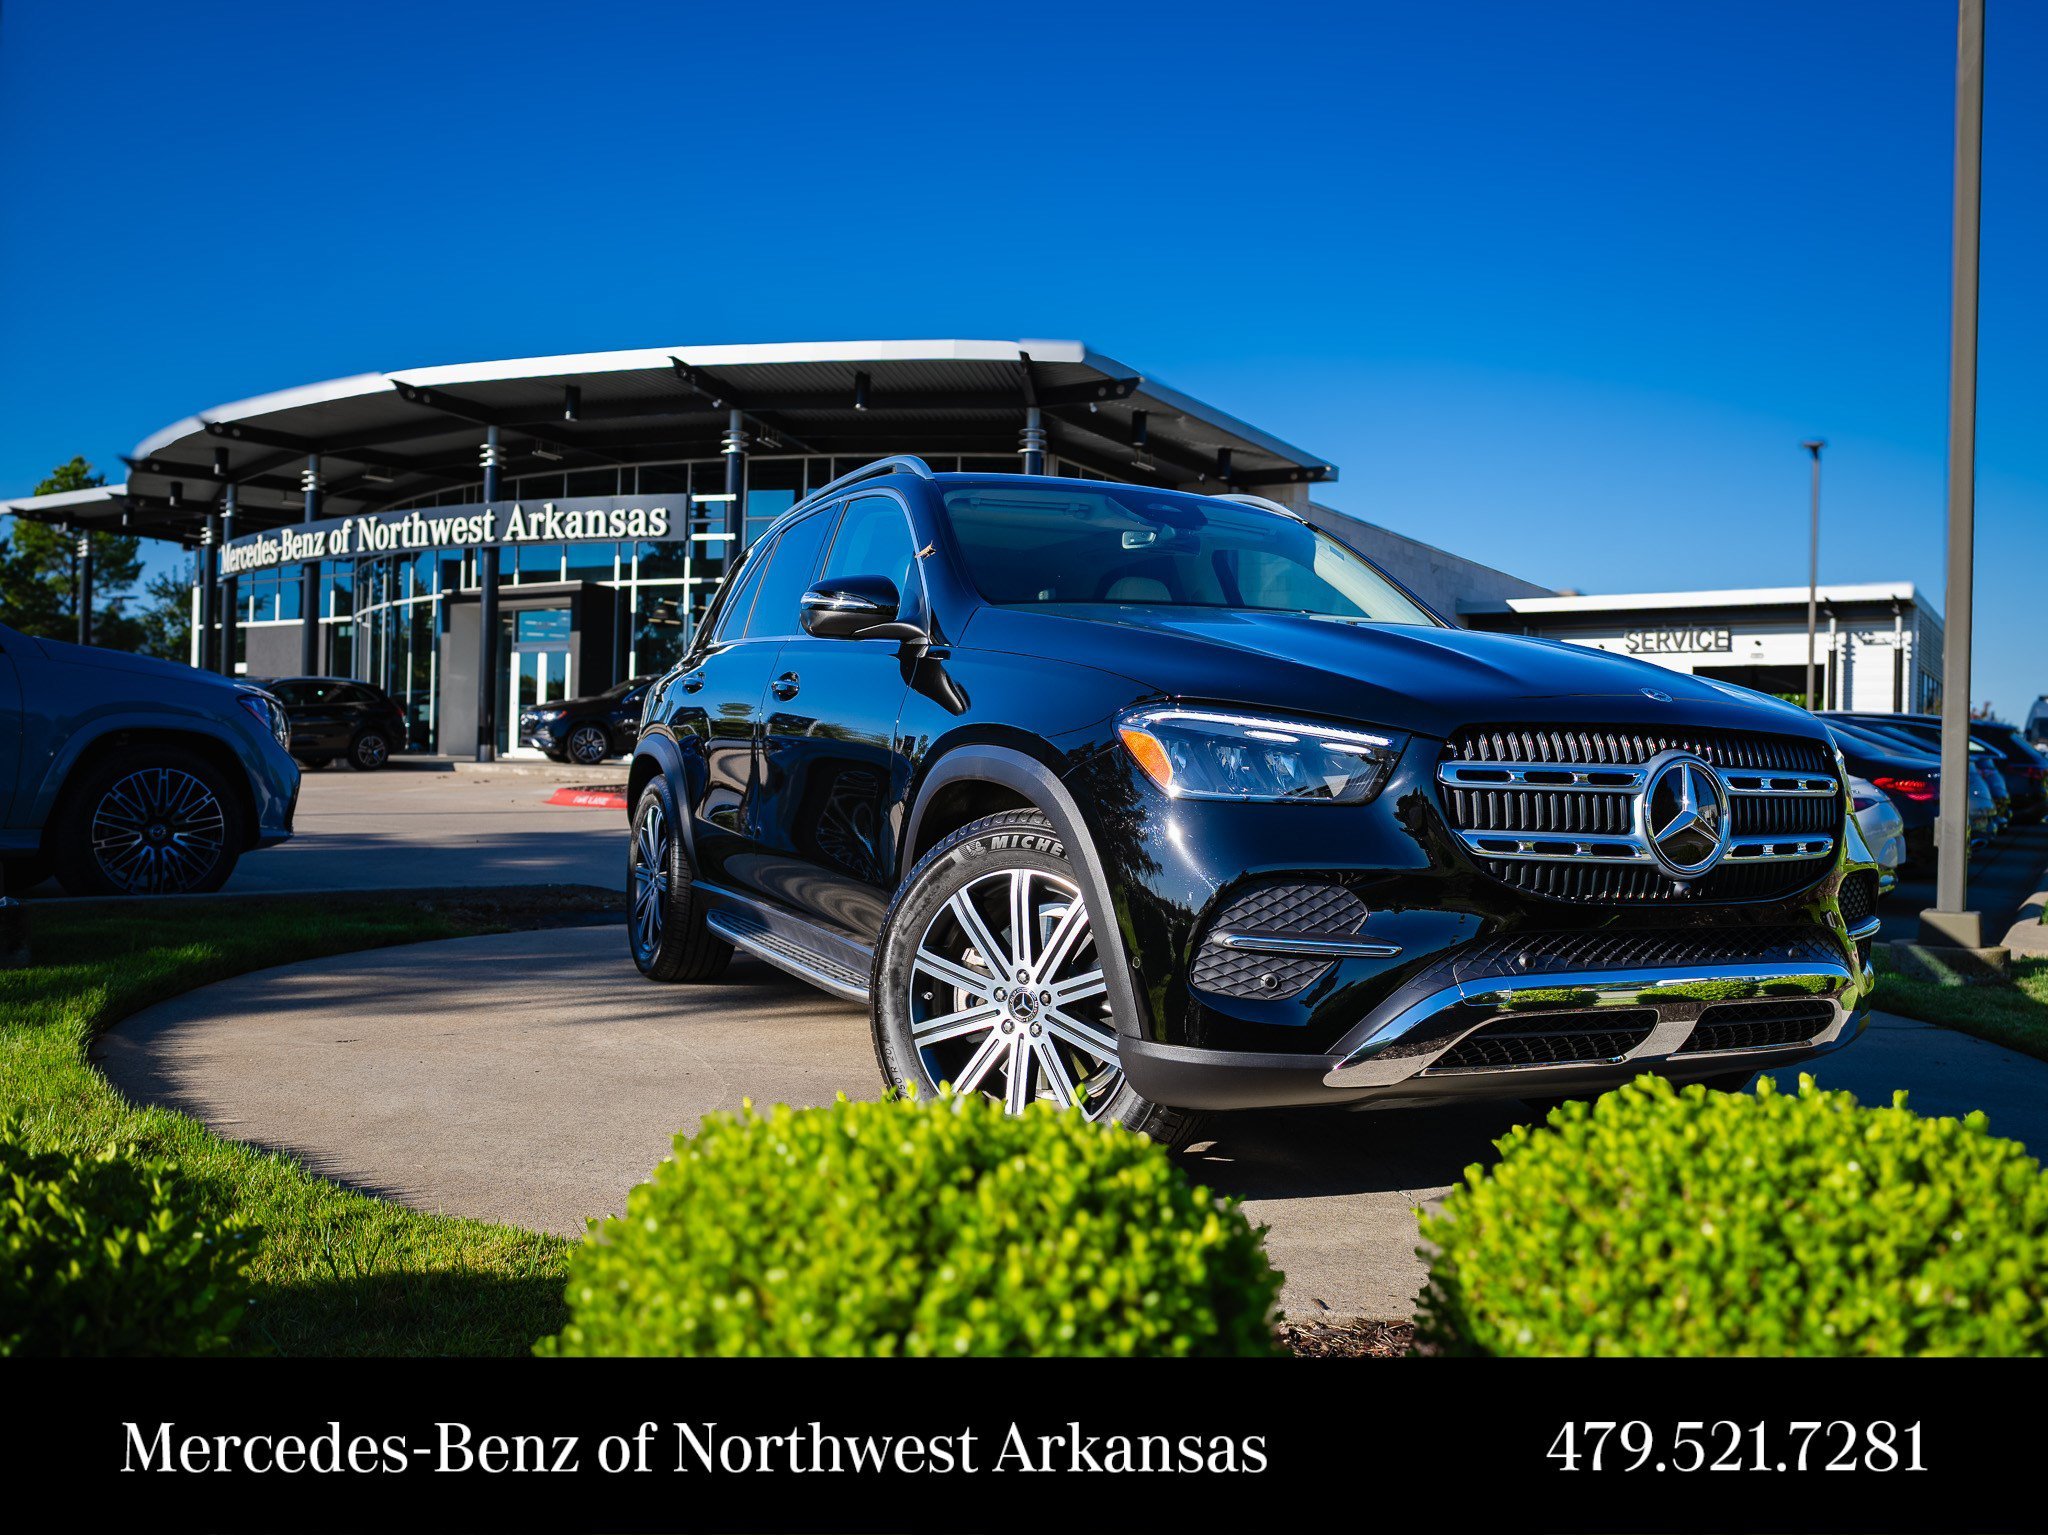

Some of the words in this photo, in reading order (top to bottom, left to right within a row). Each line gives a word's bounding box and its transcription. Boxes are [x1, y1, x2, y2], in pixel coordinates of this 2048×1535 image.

[220, 529, 325, 575] Mercedes-Benz
[328, 519, 353, 555] of
[357, 508, 495, 552] Northwest
[502, 502, 668, 542] Arkansas
[1624, 624, 1732, 654] SERVICE
[991, 835, 1069, 860] MICHE
